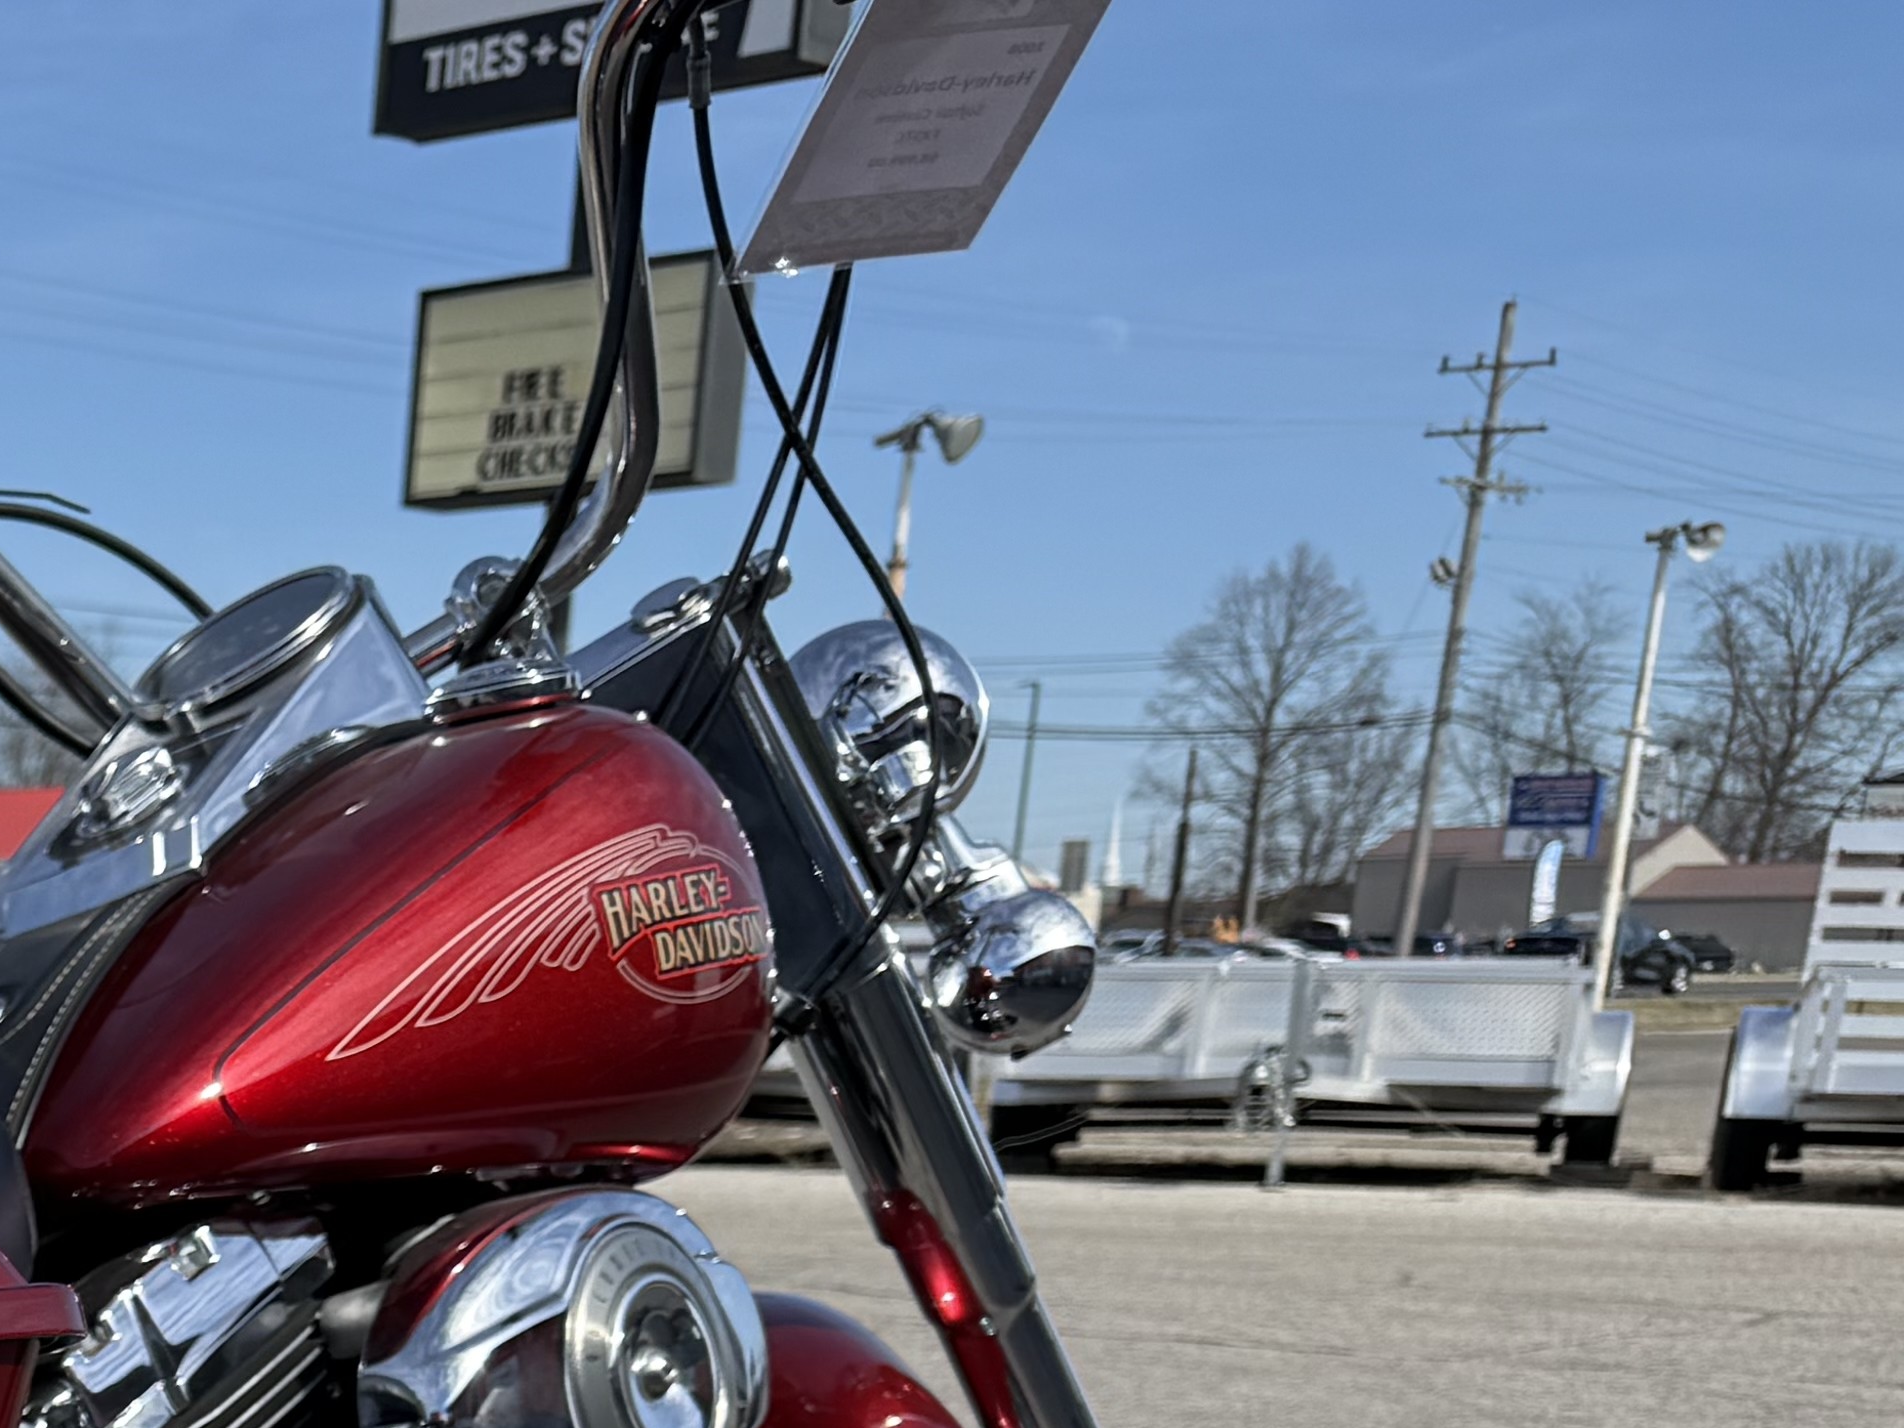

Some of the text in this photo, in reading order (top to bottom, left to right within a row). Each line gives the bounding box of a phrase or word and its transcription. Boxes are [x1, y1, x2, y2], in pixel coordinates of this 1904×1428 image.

[422, 32, 528, 93] TIRES
[489, 401, 581, 445] BRAKE
[601, 871, 726, 948] HARLEY-
[654, 914, 767, 973] DAVIDSON
